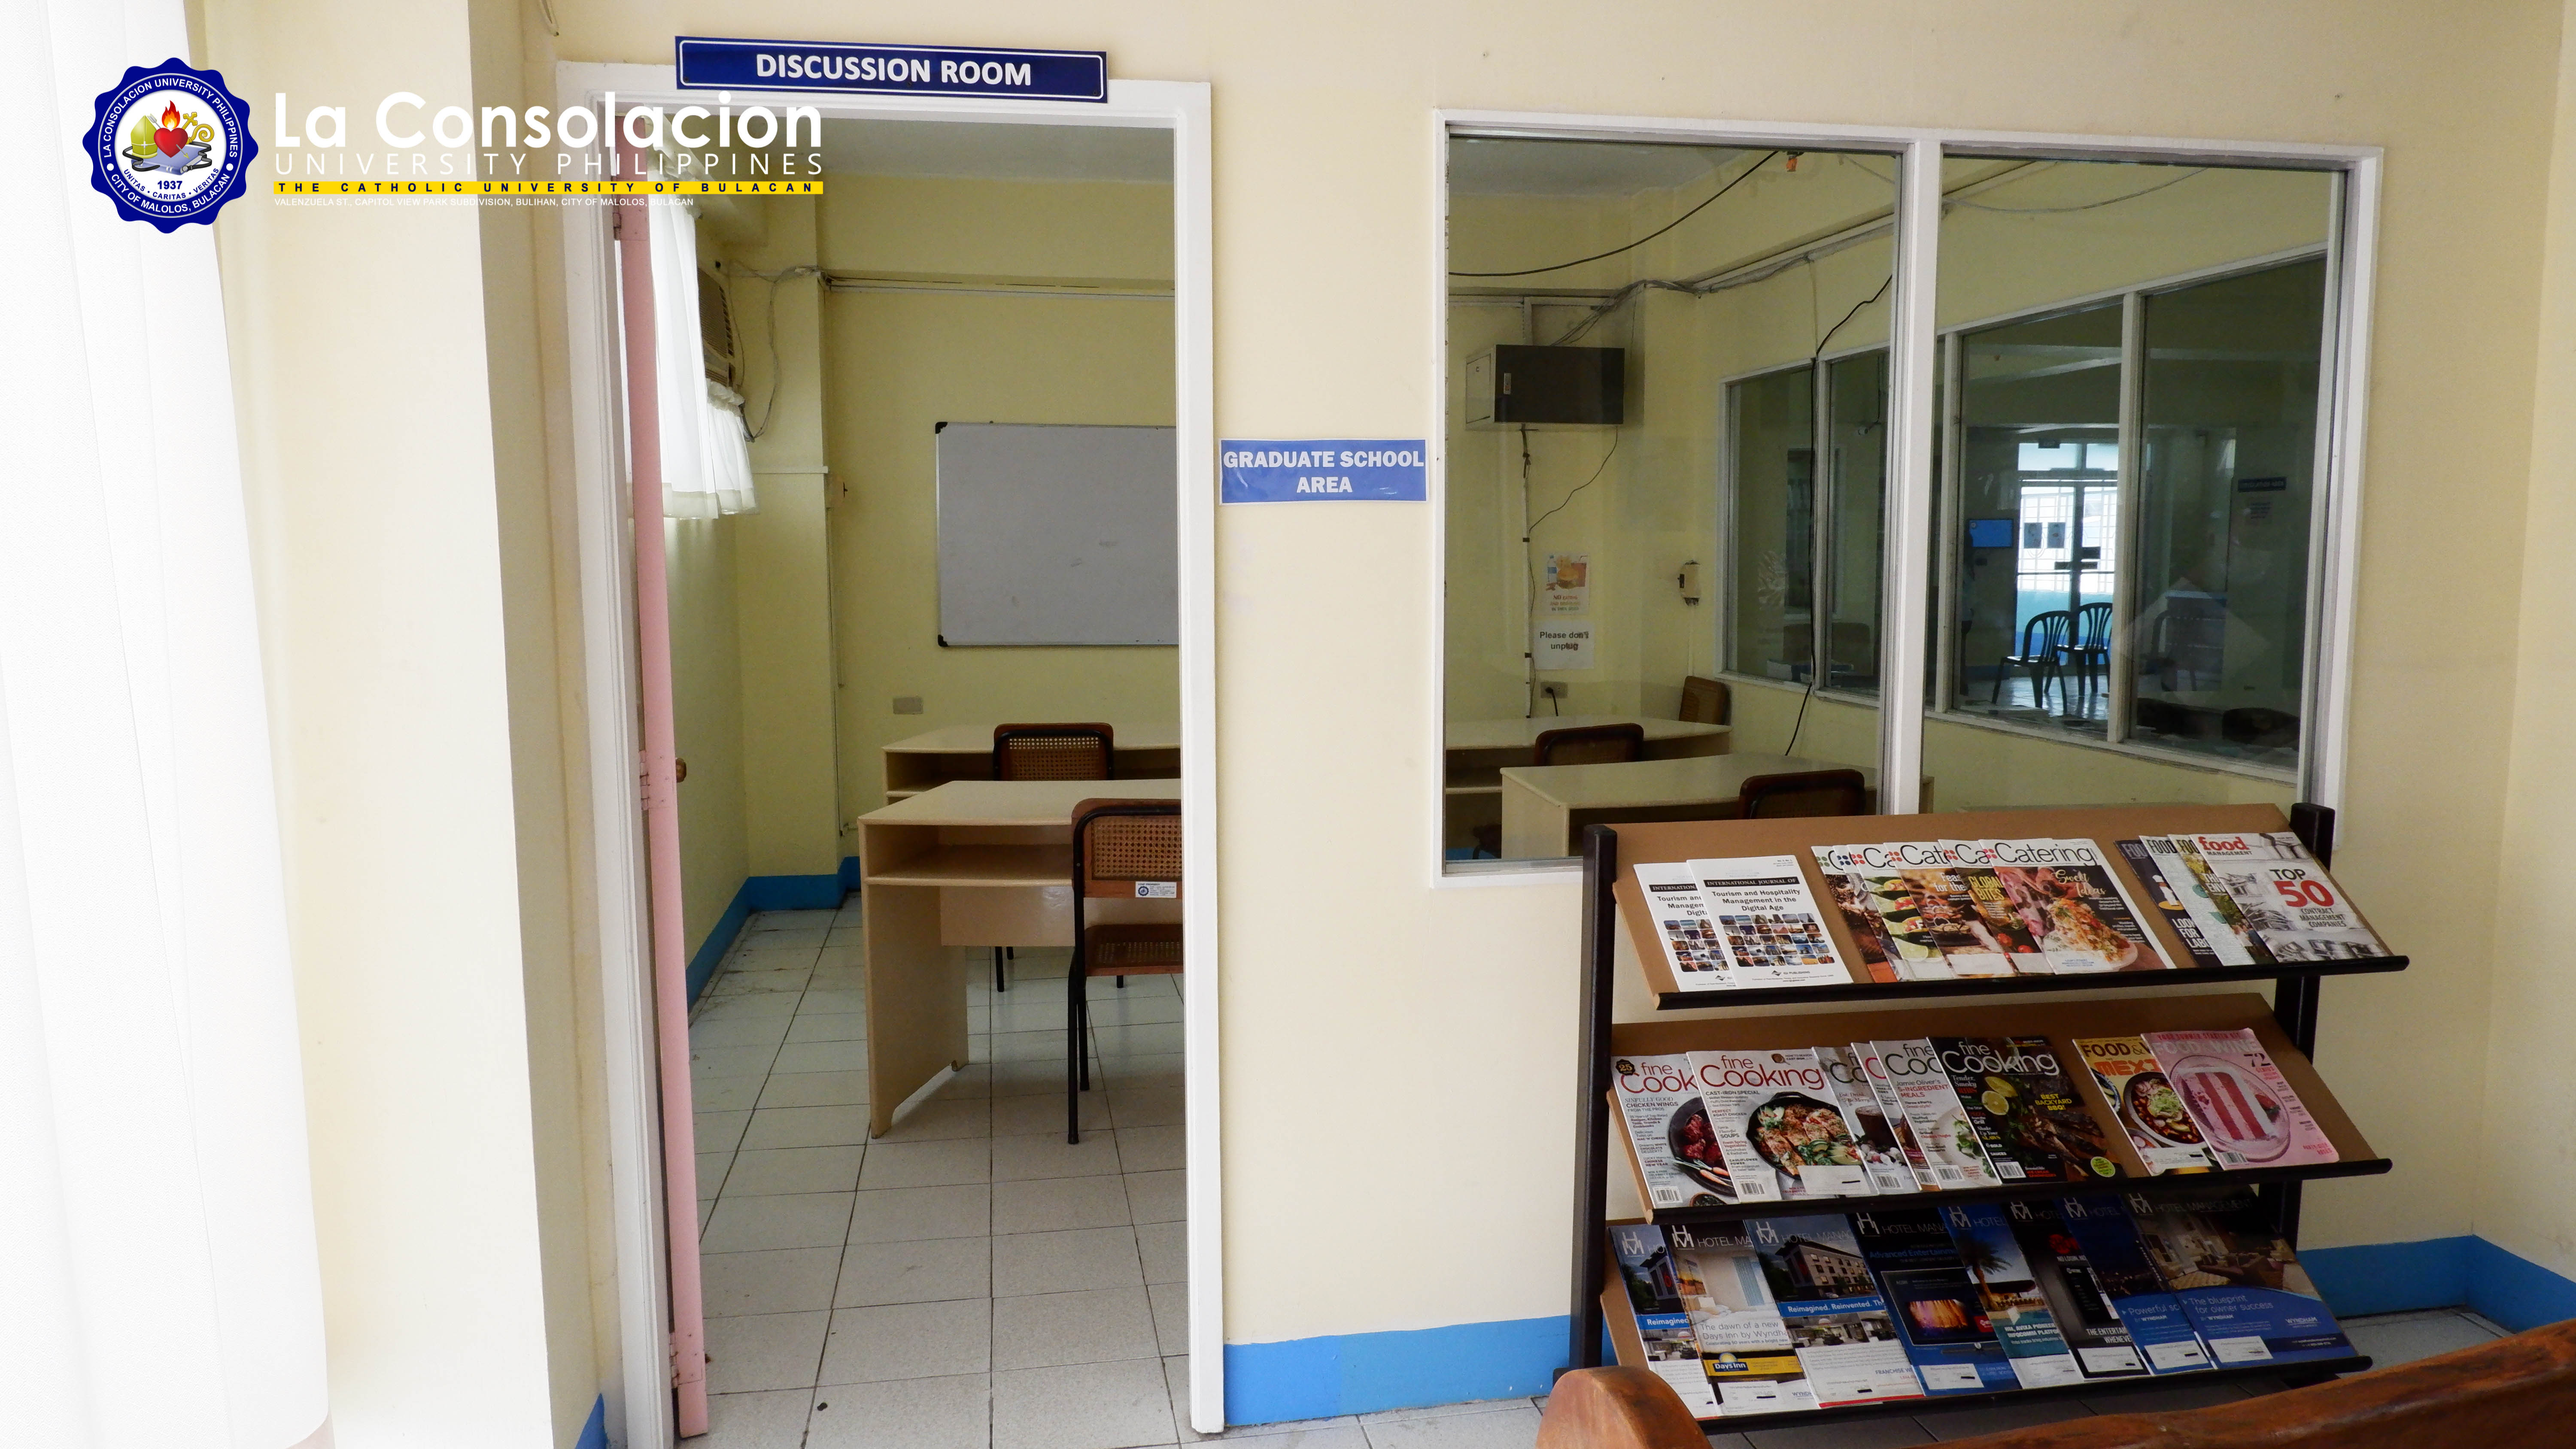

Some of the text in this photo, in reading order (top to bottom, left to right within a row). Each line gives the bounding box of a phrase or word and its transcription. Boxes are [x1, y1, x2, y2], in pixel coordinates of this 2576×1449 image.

[756, 54, 1031, 86] DISCUSSION ROOM
[1223, 451, 1424, 468] GRADUATE SCHOOL
[1296, 477, 1353, 493] AREA
[2198, 837, 2249, 851] food
[1994, 843, 2097, 866] Catering
[2269, 869, 2306, 880] TOP
[1968, 876, 2004, 888] GLOBAL
[1976, 888, 2005, 900] BITES
[2273, 880, 2334, 907] 50
[2178, 928, 2200, 938] FOR
[1903, 1044, 1935, 1057] fine
[1958, 1041, 1991, 1055] fine
[2081, 1043, 2146, 1057] FOOD &
[1721, 1055, 1753, 1069] fine
[1942, 1049, 2060, 1076] Cooking
[2244, 1053, 2271, 1067] 72
[1641, 1062, 1673, 1075] fine
[1701, 1064, 1824, 1090] Cooking
[1882, 1223, 1917, 1234] HOTEL
[1697, 1236, 1734, 1247] HOTEL
[1787, 1300, 1872, 1313] Reimagined. Reinvented.
[2188, 1294, 2248, 1306] The blueprint
[2128, 1304, 2167, 1315] Powerful
[2194, 1302, 2274, 1315] for owner success
[1702, 1332, 1723, 1340] Days
[1741, 1331, 1751, 1339] by
